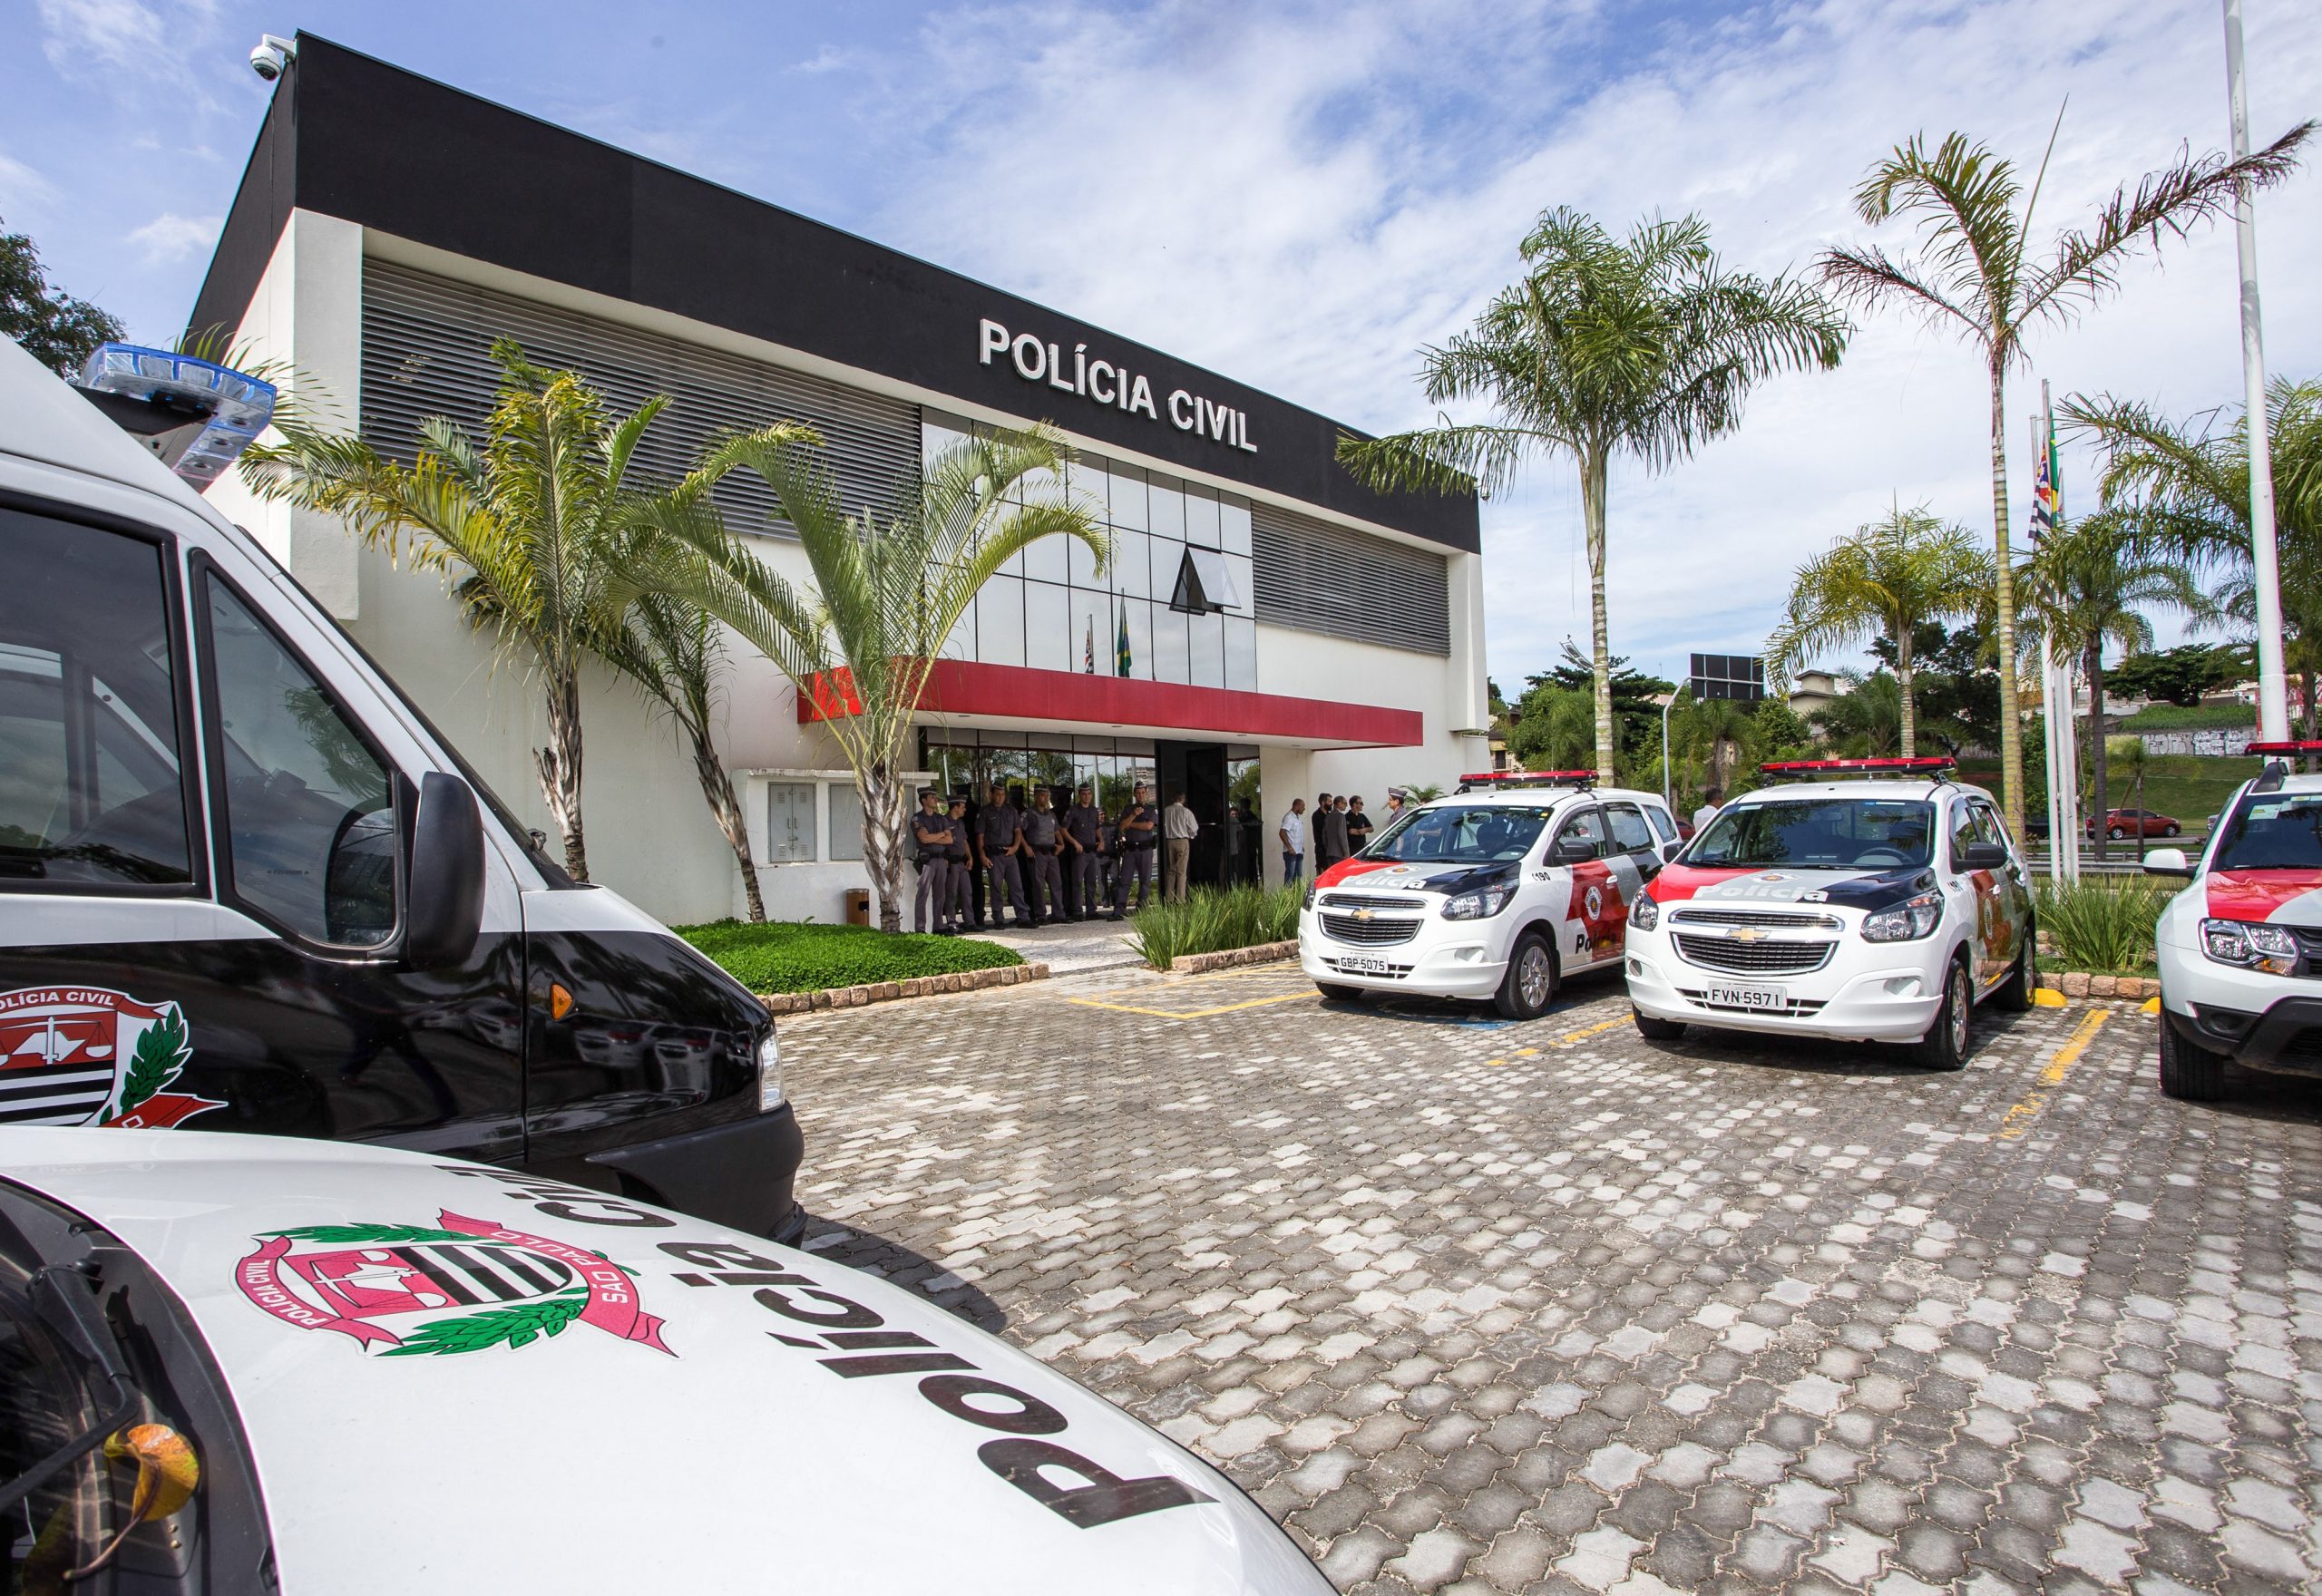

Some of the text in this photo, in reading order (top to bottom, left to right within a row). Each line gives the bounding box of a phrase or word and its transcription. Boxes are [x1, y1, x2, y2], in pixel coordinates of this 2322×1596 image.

[980, 318, 1258, 453] POLÍCIA CIVIL
[1691, 884, 1829, 902] Polícia
[0, 991, 114, 1010] LÍCIA CIVIL
[245, 1260, 328, 1326] POLÍCIA CIVIL
[491, 1231, 629, 1304] SÃO PAULO
[657, 1241, 1221, 1530] Polícia
